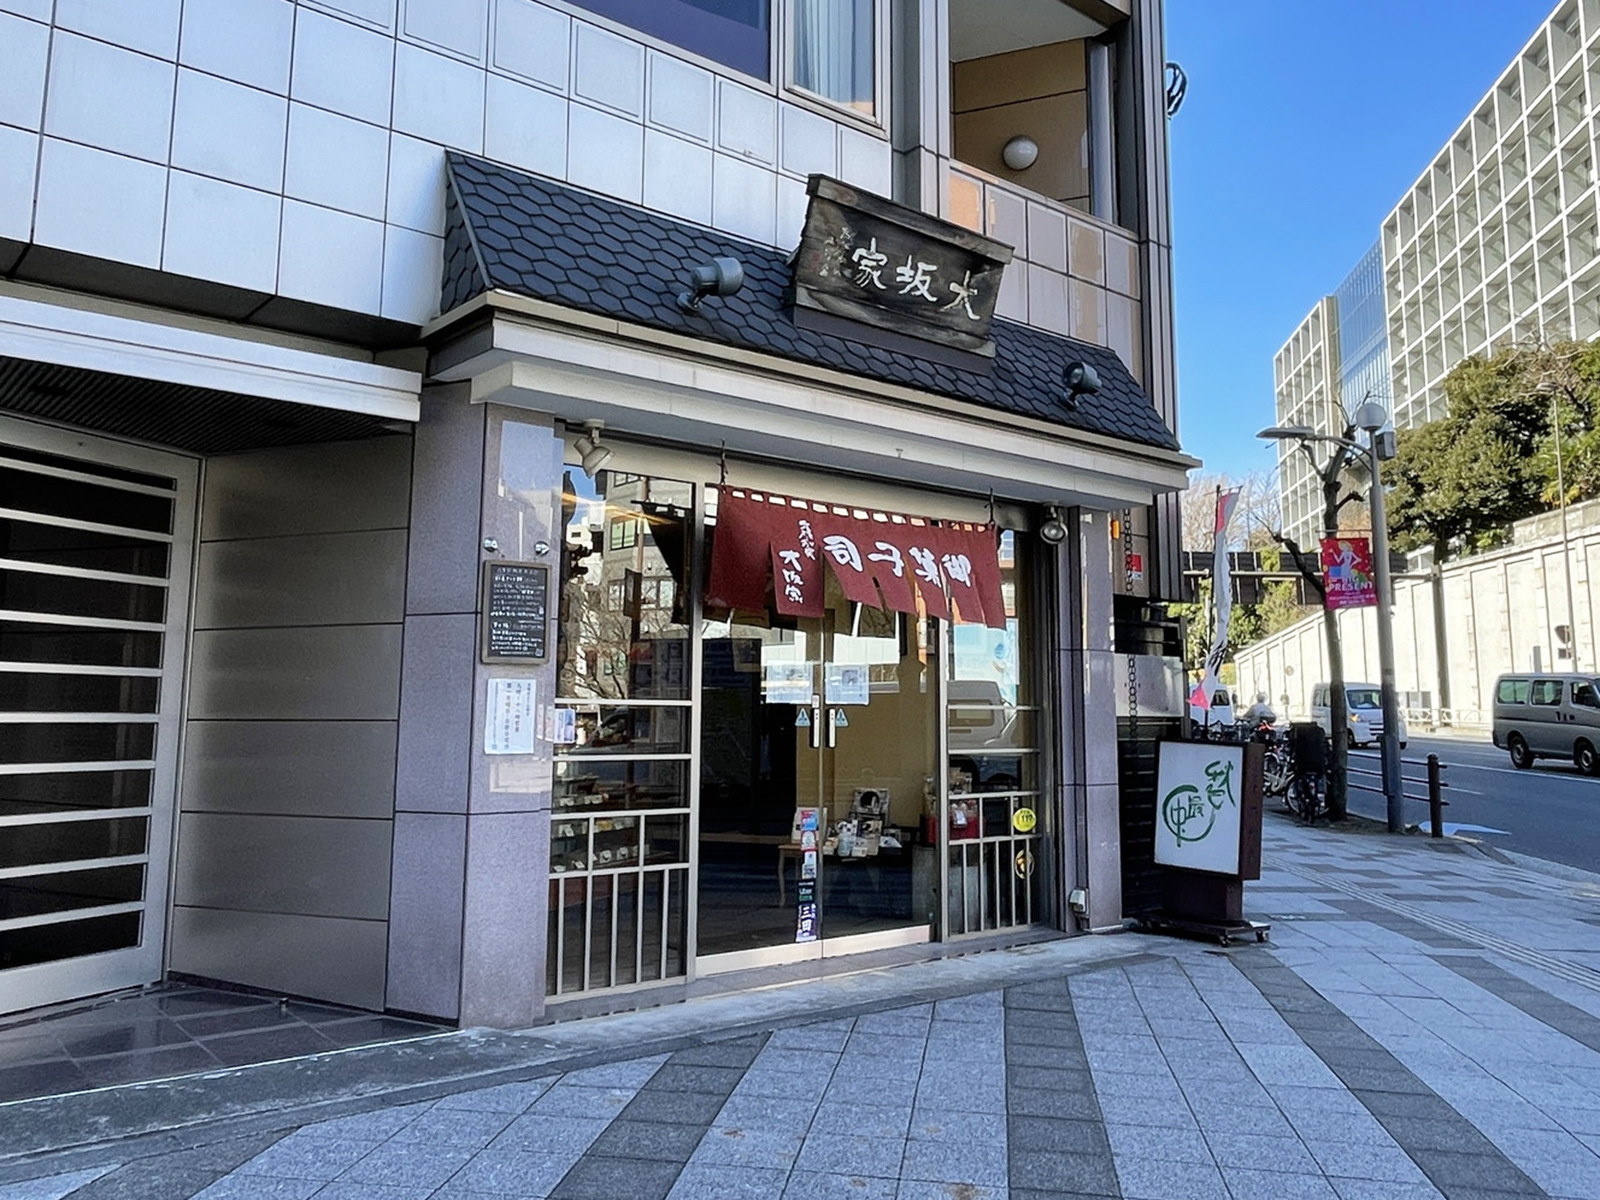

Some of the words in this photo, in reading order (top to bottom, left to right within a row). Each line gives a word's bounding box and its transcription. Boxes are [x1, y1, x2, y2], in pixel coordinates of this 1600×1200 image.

[852, 237, 981, 320] 大坂家
[823, 535, 972, 588] 御菓子司
[1329, 580, 1373, 592] PRESENT
